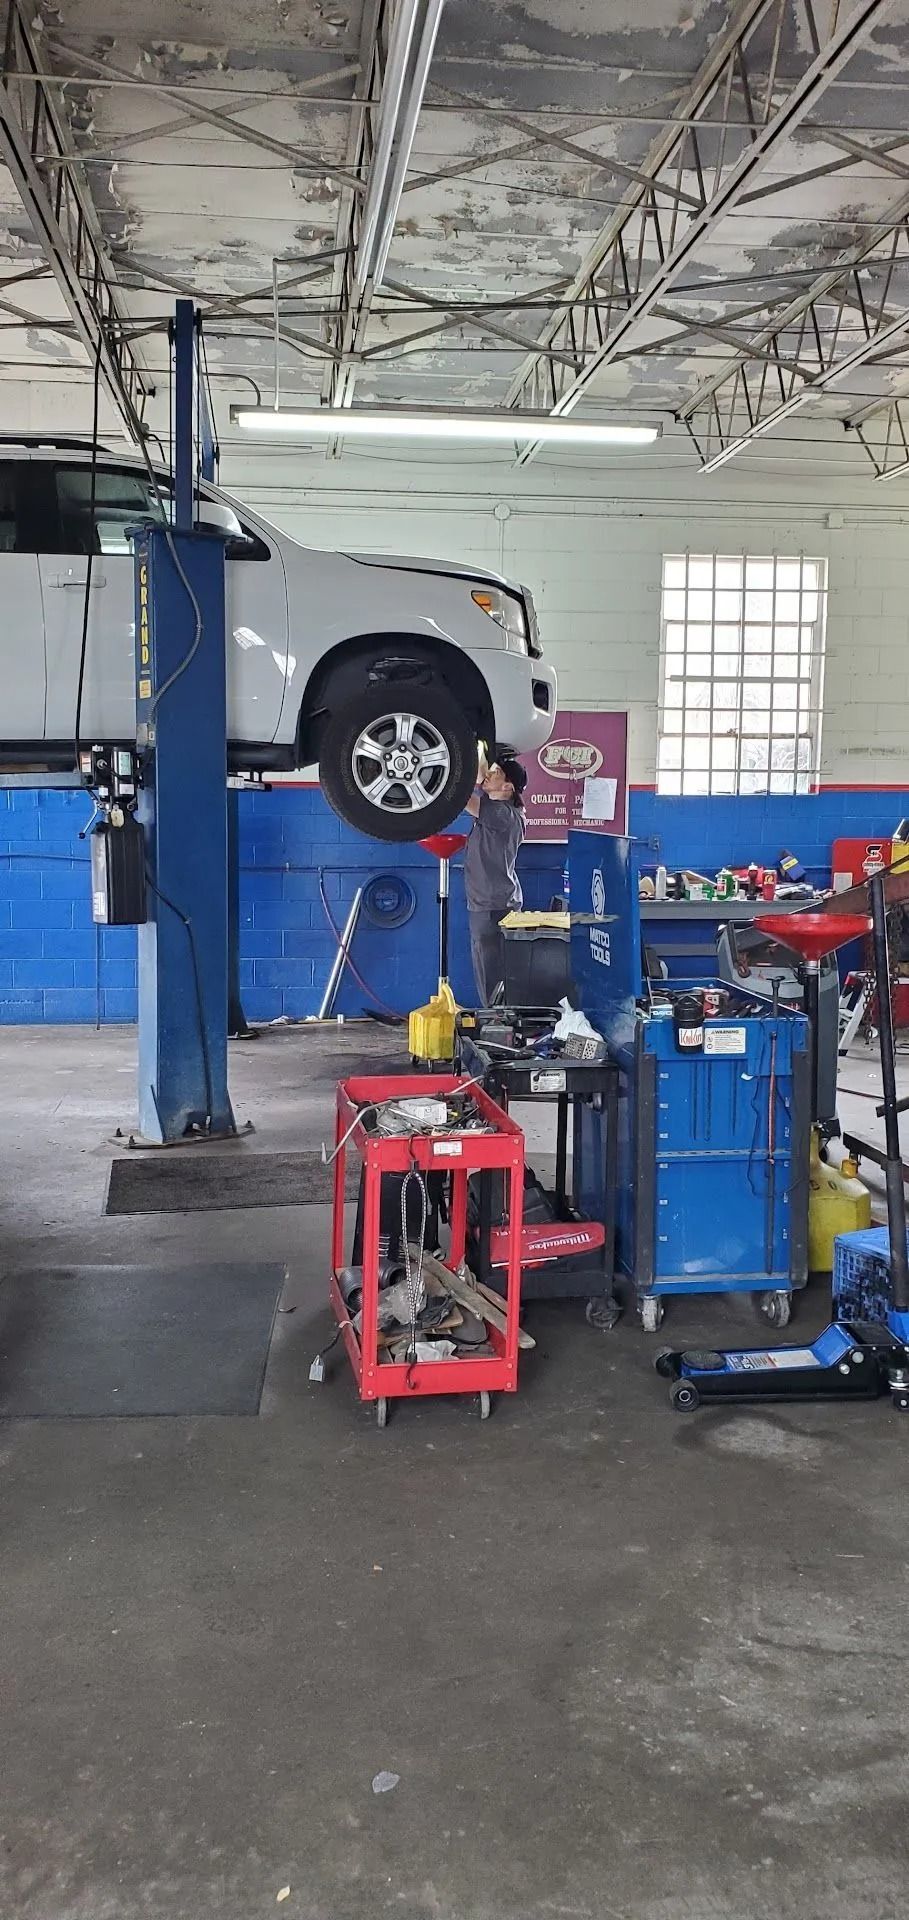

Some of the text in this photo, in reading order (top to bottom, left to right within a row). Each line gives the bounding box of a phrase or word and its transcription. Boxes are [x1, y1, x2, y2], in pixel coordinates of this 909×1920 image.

[139, 565, 149, 665] GRAND
[531, 794, 566, 804] QUALITY
[555, 807, 567, 815] FOR
[589, 926, 610, 949] MATCO
[590, 943, 611, 967] TOOLS
[528, 1233, 593, 1251] Milwaukee
